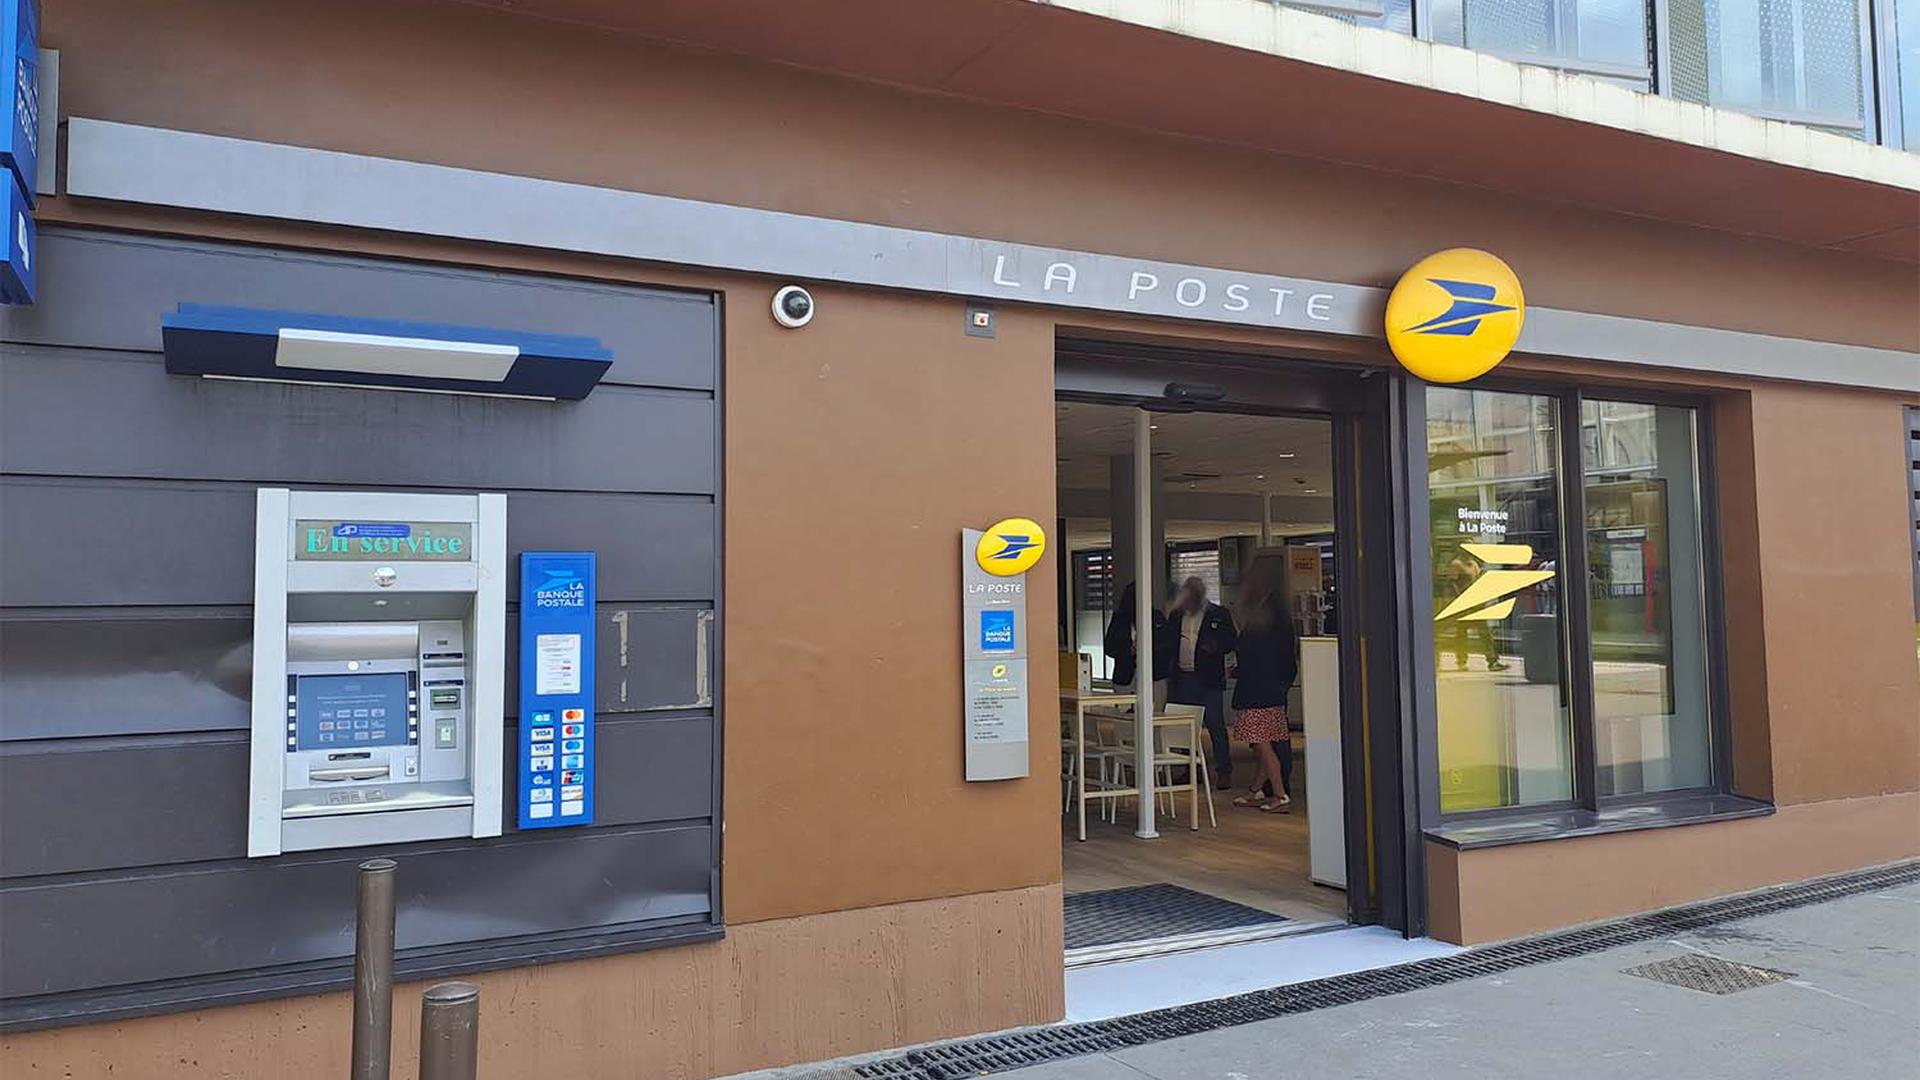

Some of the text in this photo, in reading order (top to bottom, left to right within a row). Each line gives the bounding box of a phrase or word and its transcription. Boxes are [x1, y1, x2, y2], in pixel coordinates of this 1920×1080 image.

[993, 255, 1334, 321] LA POSTE
[1458, 508, 1508, 520] Bienvenue
[1459, 523, 1506, 533] à La Poste
[307, 528, 348, 554] En
[361, 529, 463, 554] service
[569, 582, 585, 590] LA
[969, 584, 1021, 593] LA POSTE
[537, 599, 585, 607] POSTALE
